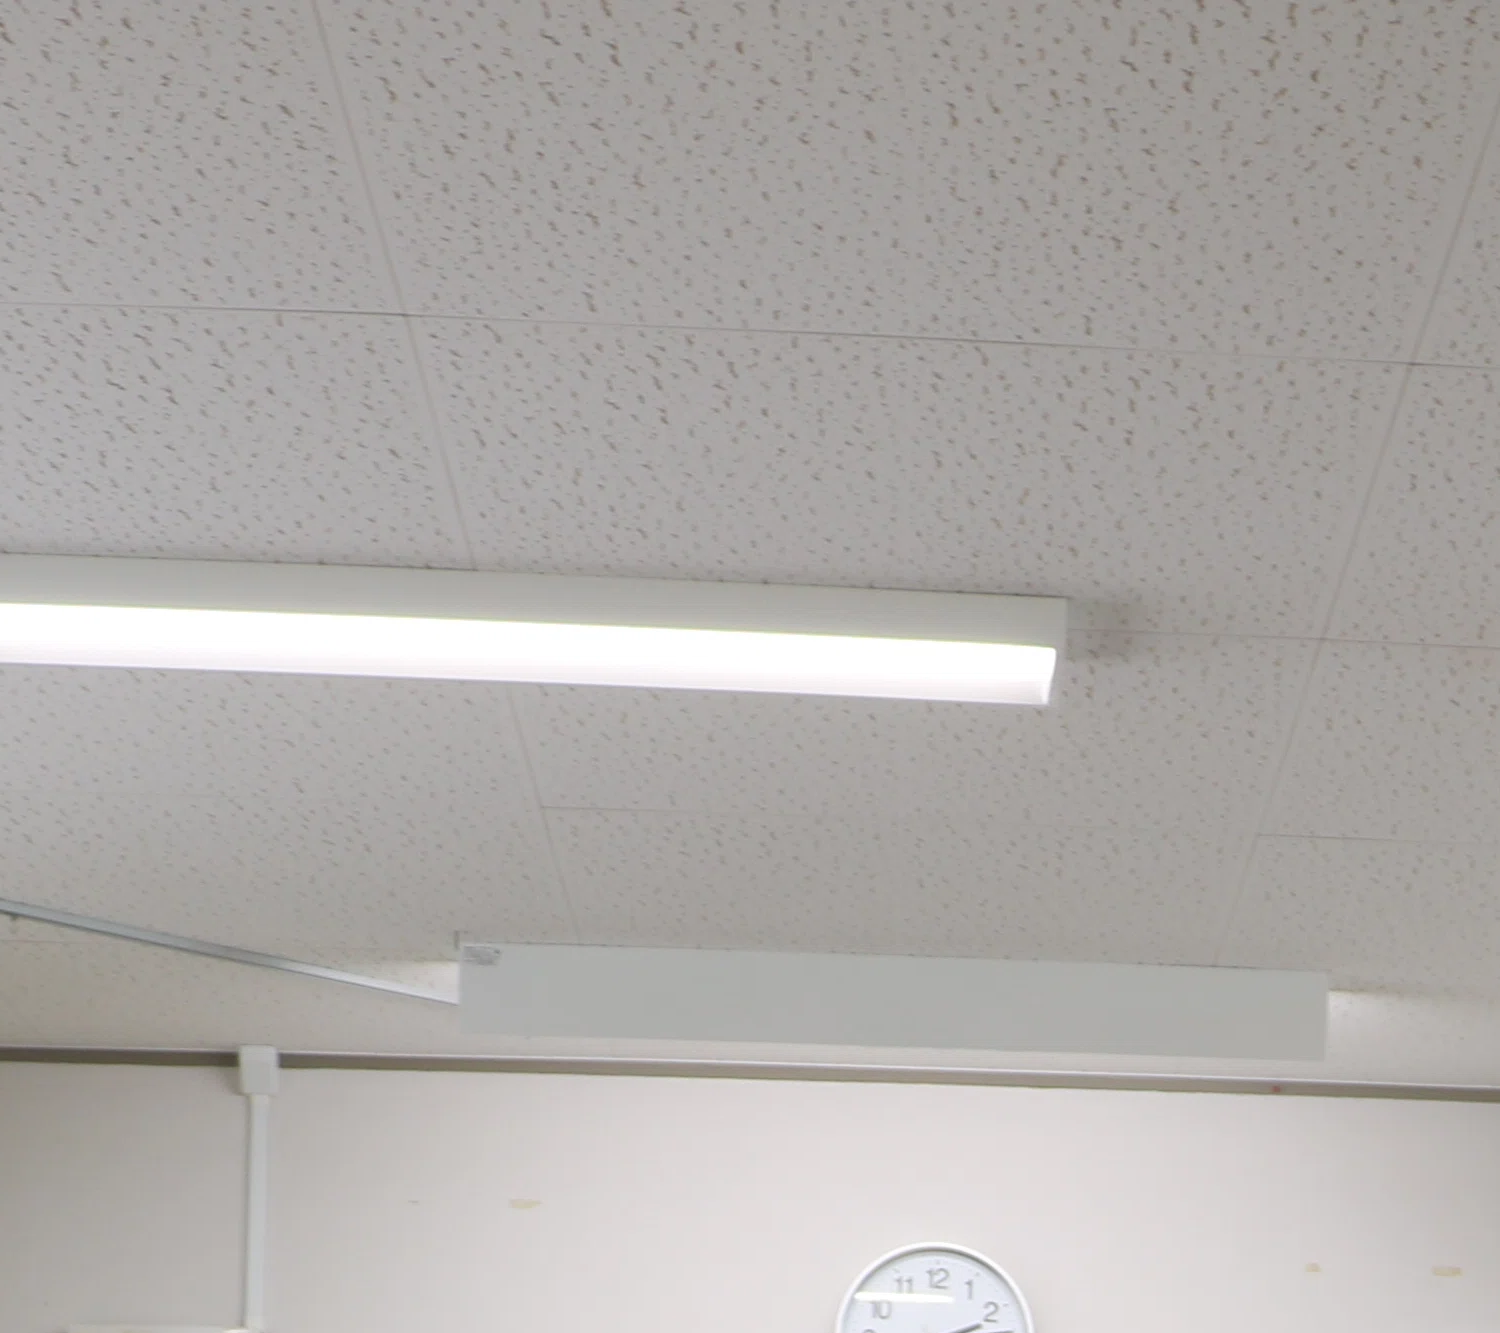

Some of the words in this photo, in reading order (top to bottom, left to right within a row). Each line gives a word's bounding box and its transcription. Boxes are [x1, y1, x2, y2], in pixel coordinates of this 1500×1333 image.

[896, 1277, 914, 1294] 11
[926, 1268, 949, 1289] 12
[965, 1280, 974, 1300] 1
[871, 1301, 892, 1319] 10
[983, 1302, 999, 1323] 2
